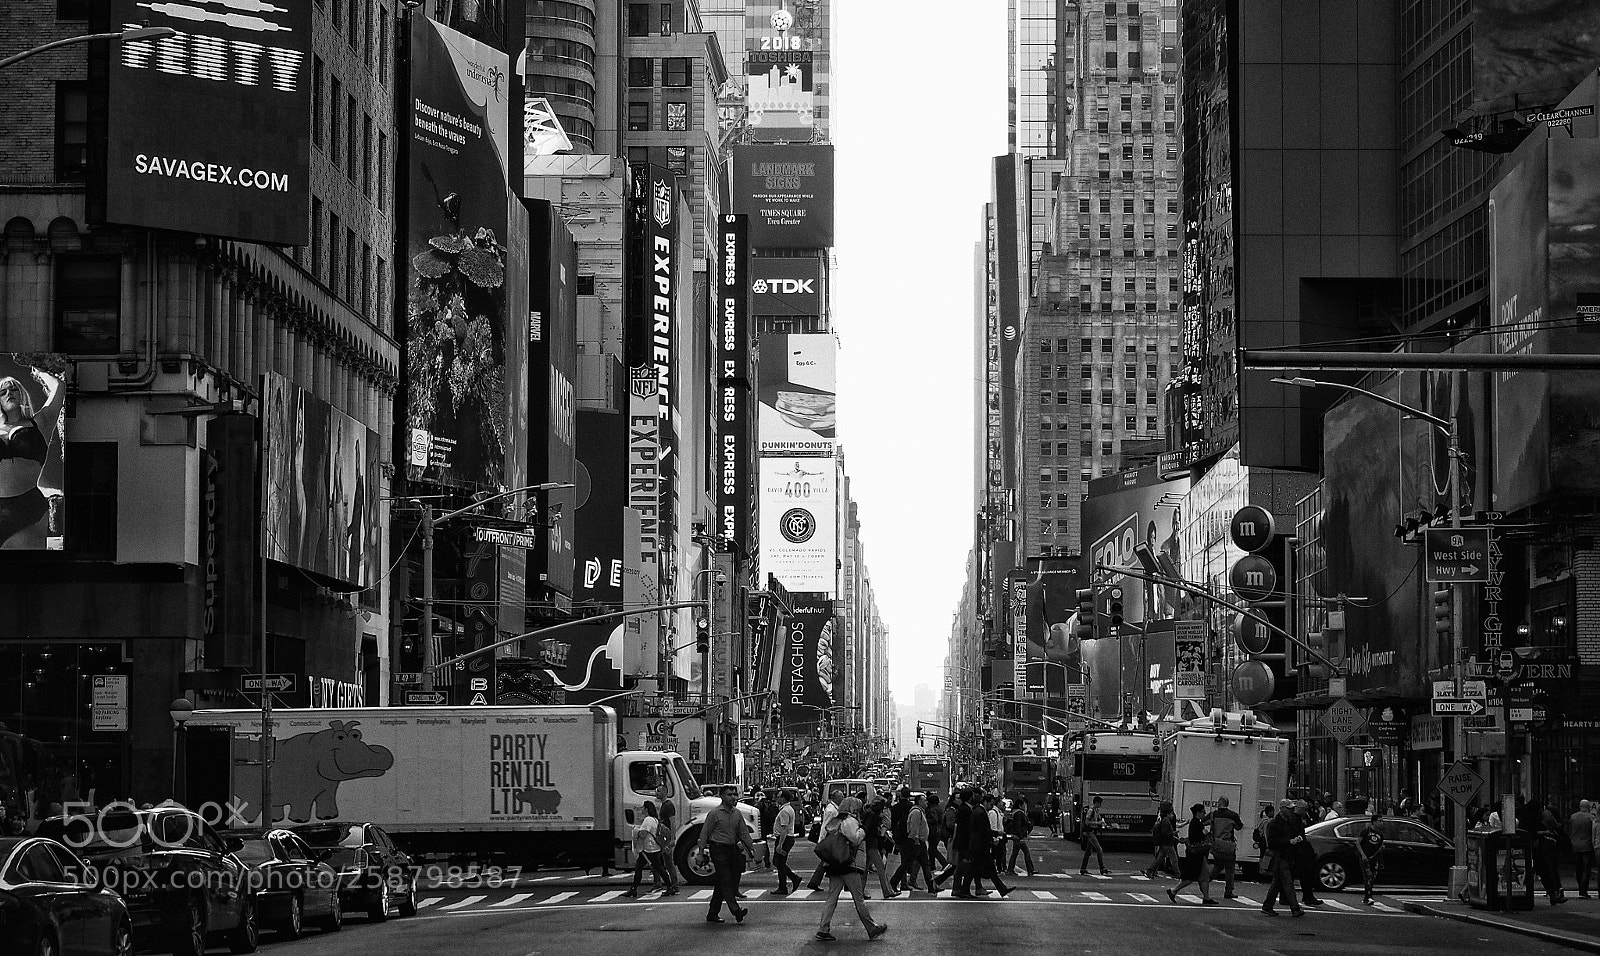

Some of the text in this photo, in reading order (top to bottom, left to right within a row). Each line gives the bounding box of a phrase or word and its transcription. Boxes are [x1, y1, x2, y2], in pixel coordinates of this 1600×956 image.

[760, 36, 801, 50] 2018
[752, 52, 812, 63] TOSHIBA
[415, 98, 482, 138] Discover nature's beauty
[414, 114, 466, 145] beneath the waves
[135, 154, 288, 192] SAVAGEX.COM
[752, 163, 815, 176] LANDMARK
[765, 177, 801, 189] SIGNS
[655, 199, 669, 221] NFL
[781, 209, 807, 218] SQUARE
[725, 233, 736, 286] EXPRESS
[767, 279, 815, 294] TDK
[530, 311, 541, 342] MARVEL
[653, 235, 670, 421] EXPERIENCE
[724, 298, 735, 351] EXPRESS
[633, 380, 656, 393] NFL
[724, 435, 735, 495] EXPRESS
[785, 482, 811, 498] 400
[1239, 521, 1256, 536] m
[1452, 535, 1464, 545] 9A
[1433, 550, 1482, 560] West Side
[1246, 570, 1264, 586] m
[1436, 566, 1456, 576] Hwy
[1254, 622, 1268, 638] m
[791, 622, 804, 705] PISTACHIOS
[1475, 665, 1482, 674] W
[271, 680, 288, 688] WAY
[1238, 677, 1254, 691] m
[321, 677, 336, 707] NY
[337, 681, 364, 707] GIFTS
[1488, 698, 1503, 706] M104
[1331, 707, 1353, 715] RIGHT
[461, 718, 487, 726] Maryland
[496, 717, 527, 725] Washington
[1332, 725, 1352, 733] ENDS
[490, 734, 548, 760] PARTY
[490, 761, 556, 787] RENTAL
[1448, 773, 1472, 784] RAISE
[1451, 785, 1473, 794] PLOW
[490, 788, 523, 814] LTD
